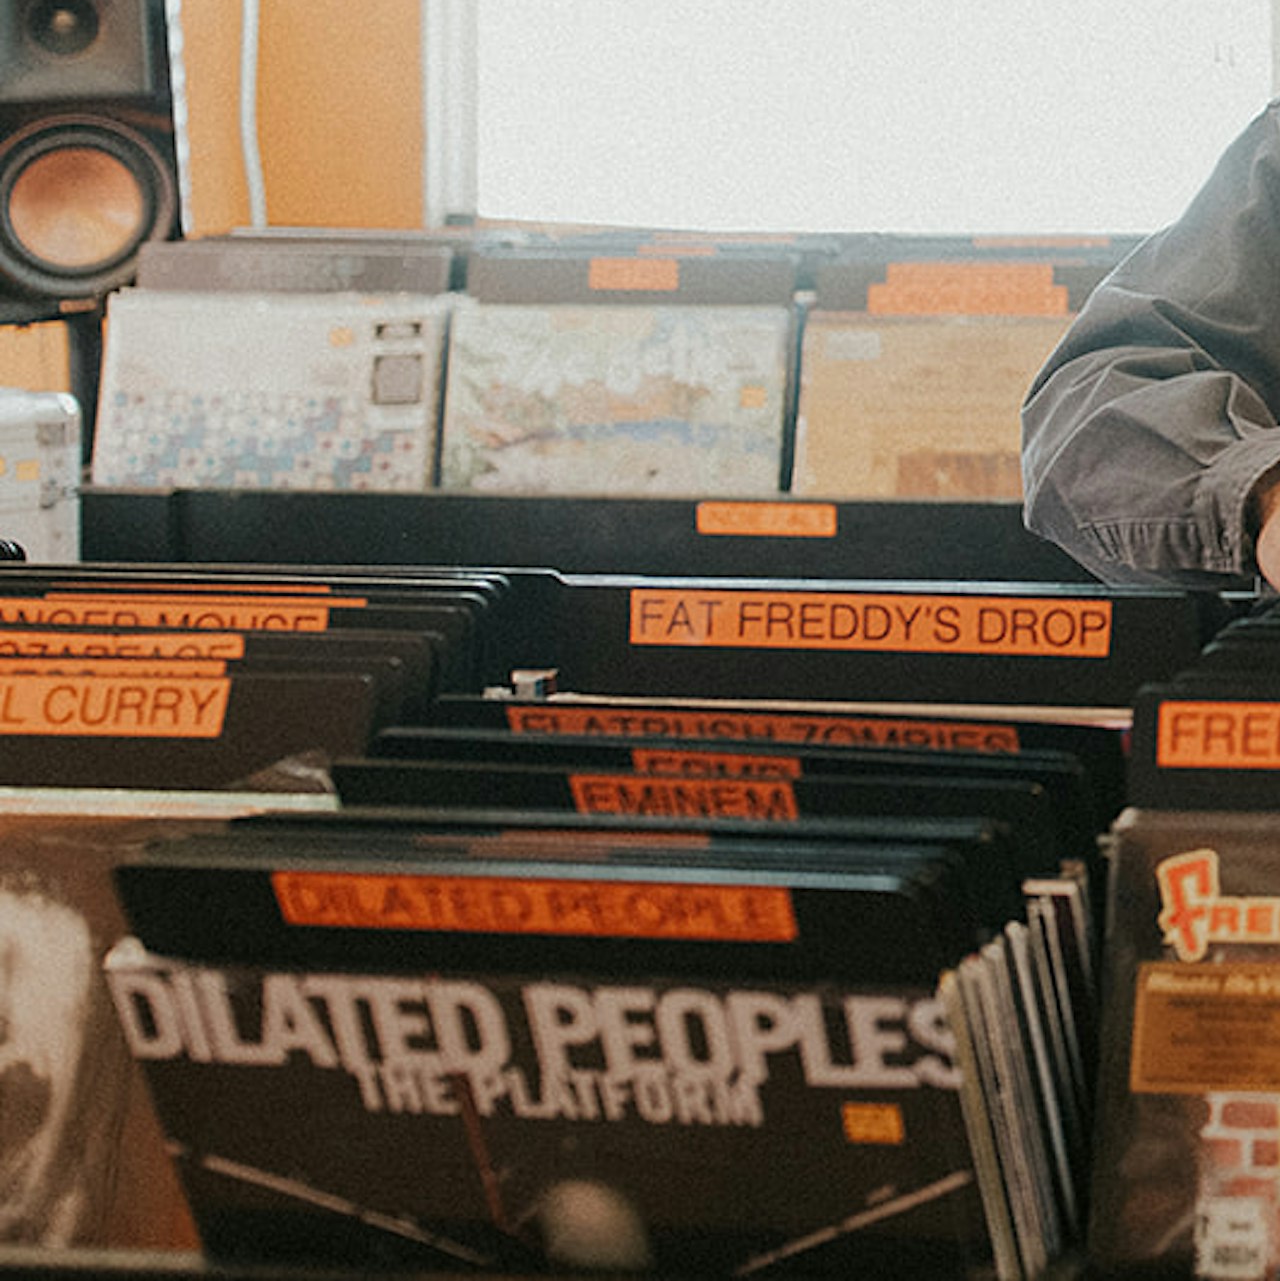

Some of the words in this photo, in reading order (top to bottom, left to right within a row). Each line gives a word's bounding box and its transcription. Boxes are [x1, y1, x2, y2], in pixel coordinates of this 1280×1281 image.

[638, 598, 727, 635] FAT
[738, 601, 961, 645] FREDDY'S
[978, 606, 1107, 649] DROP
[43, 684, 220, 726] CURRY
[582, 782, 791, 819] EMINEM
[107, 971, 513, 1069] DILATED
[521, 982, 963, 1090] PEOPLES
[350, 1066, 460, 1114] THE
[476, 1072, 766, 1128] PLATFORM
